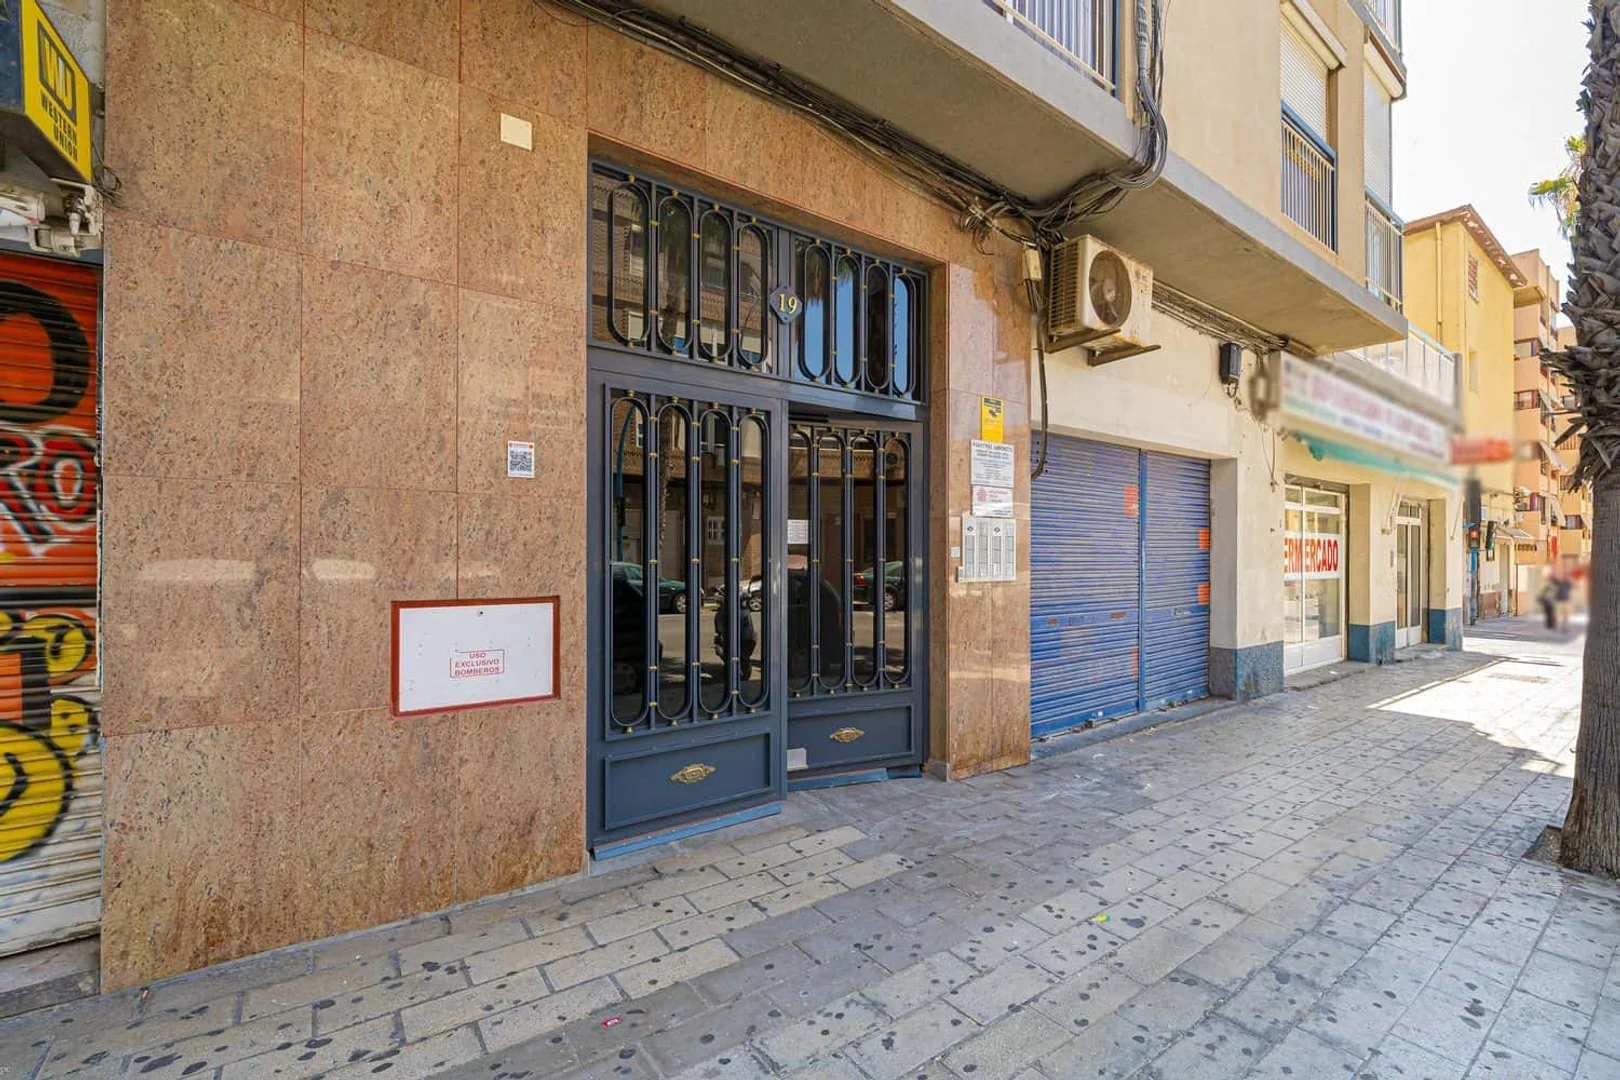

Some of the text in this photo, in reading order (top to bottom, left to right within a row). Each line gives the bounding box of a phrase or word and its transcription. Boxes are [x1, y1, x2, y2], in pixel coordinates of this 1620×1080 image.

[41, 89, 77, 147] WESTERN
[53, 123, 77, 163] UNION
[778, 293, 798, 314] 19
[455, 659, 500, 668] EXCLUSIVO
[455, 666, 500, 677] BOMBEROS
